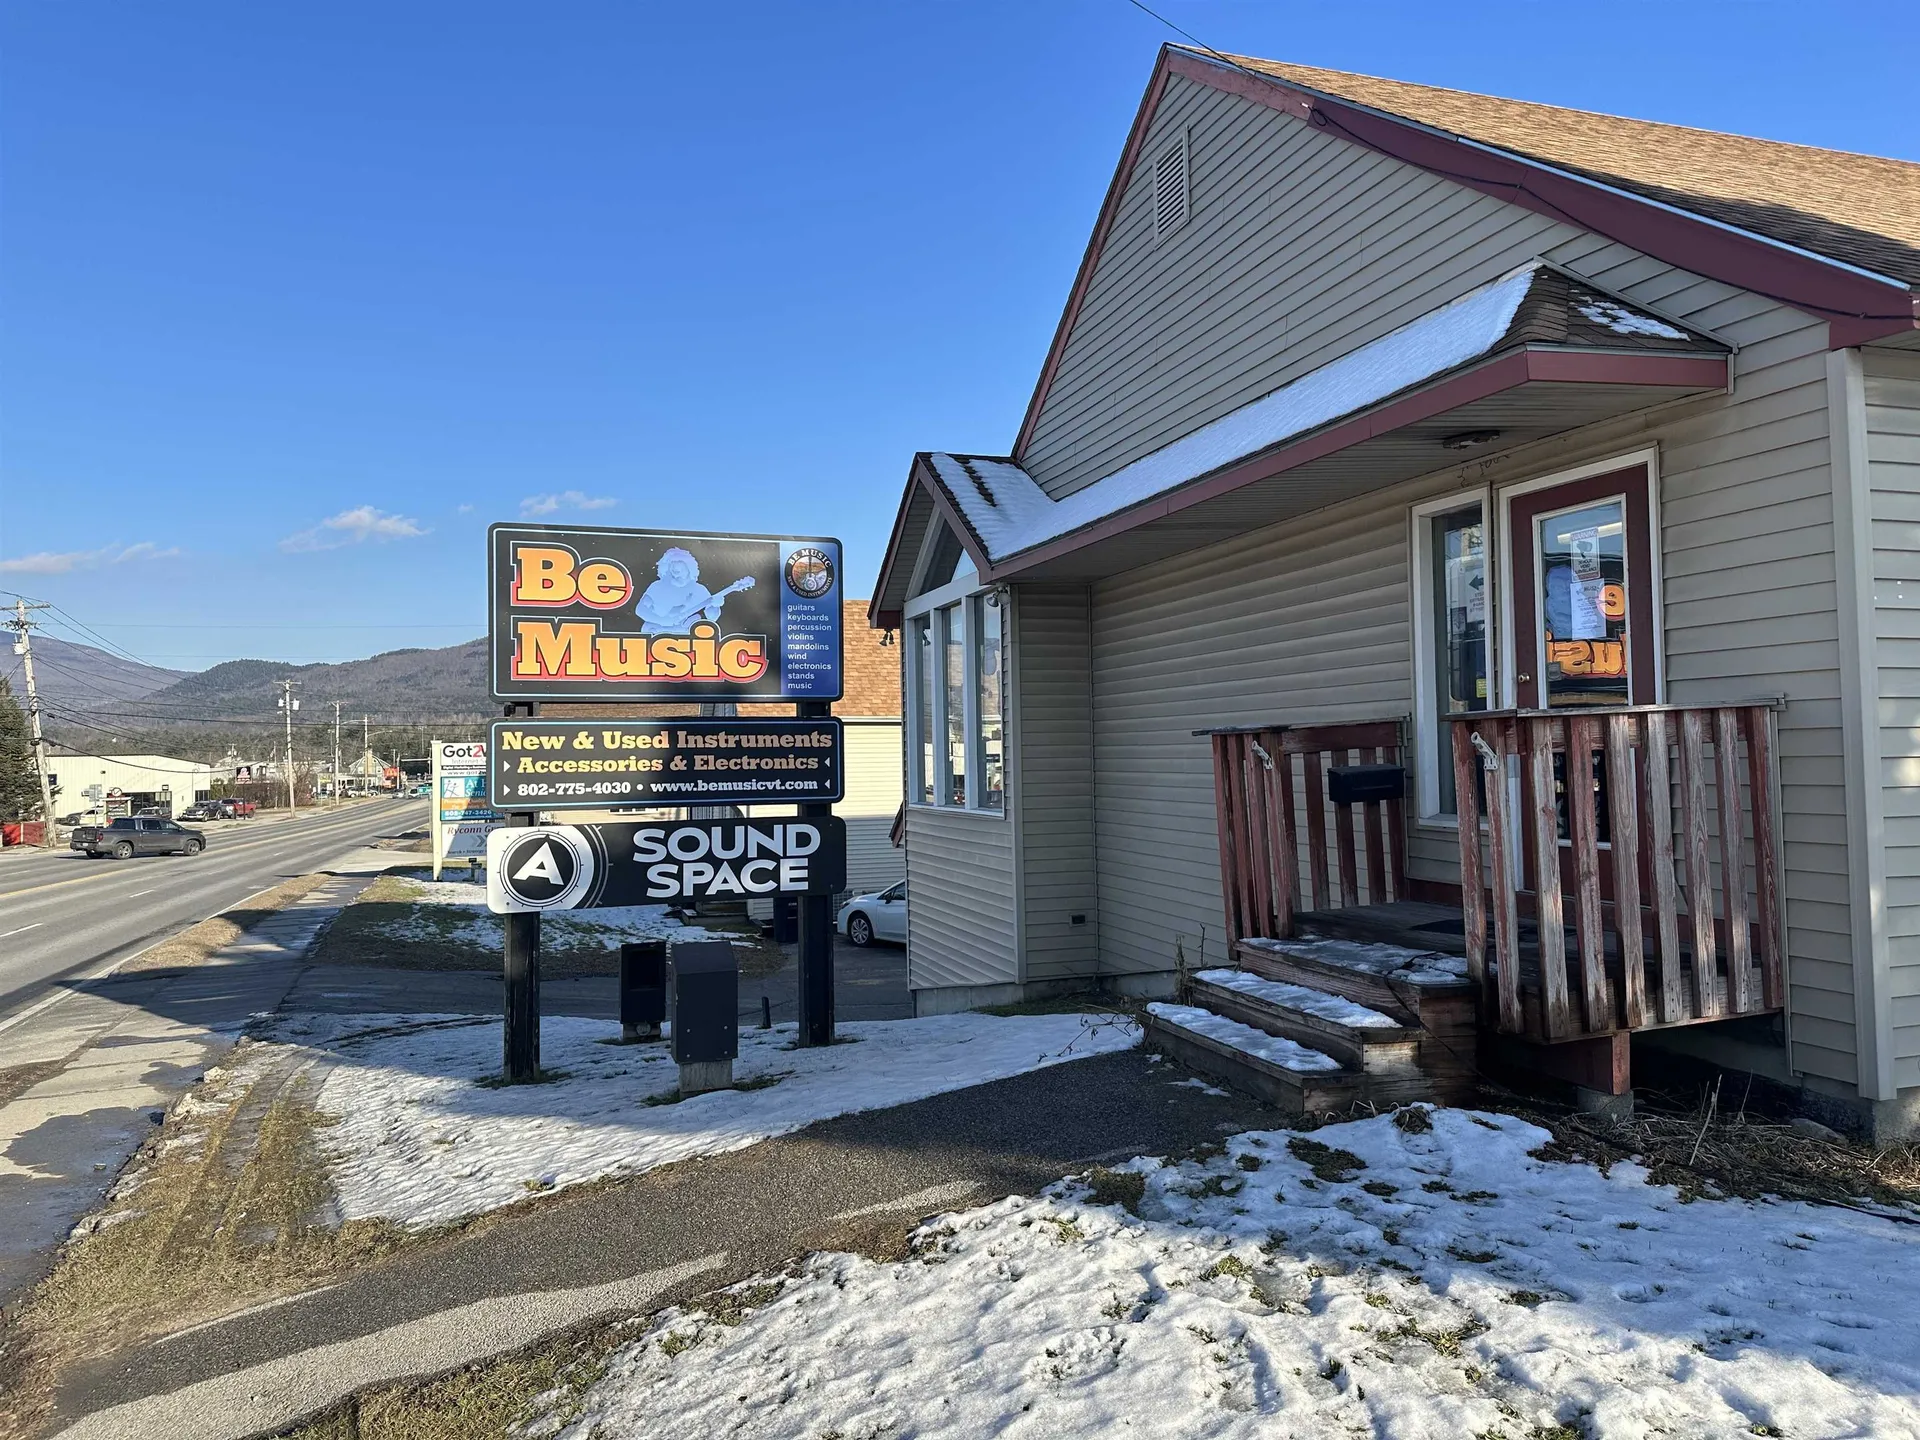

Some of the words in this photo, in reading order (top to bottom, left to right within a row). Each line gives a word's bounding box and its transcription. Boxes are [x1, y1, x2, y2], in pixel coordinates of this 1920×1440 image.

[788, 553, 800, 565] BE
[801, 549, 831, 567] MUSIC
[512, 543, 632, 608] Be
[796, 588, 807, 596] USED
[808, 577, 832, 597] INSTRUMENTS
[788, 604, 815, 612] guitars
[788, 614, 829, 622] keyboards
[512, 617, 767, 681] Music
[788, 652, 806, 660] wind
[502, 731, 566, 751] New
[573, 731, 595, 750] &
[602, 730, 669, 749] Used
[677, 730, 832, 748] Instruments
[517, 755, 663, 773] Accessories
[670, 755, 687, 771] &
[694, 753, 818, 770] Electronics
[518, 782, 631, 797] 802-775-4030
[650, 779, 818, 793] www.bemusicvt.com
[447, 826, 482, 836] Ryconn
[632, 823, 820, 863] SOUND
[513, 841, 564, 885] A
[646, 858, 809, 898] SPACE
